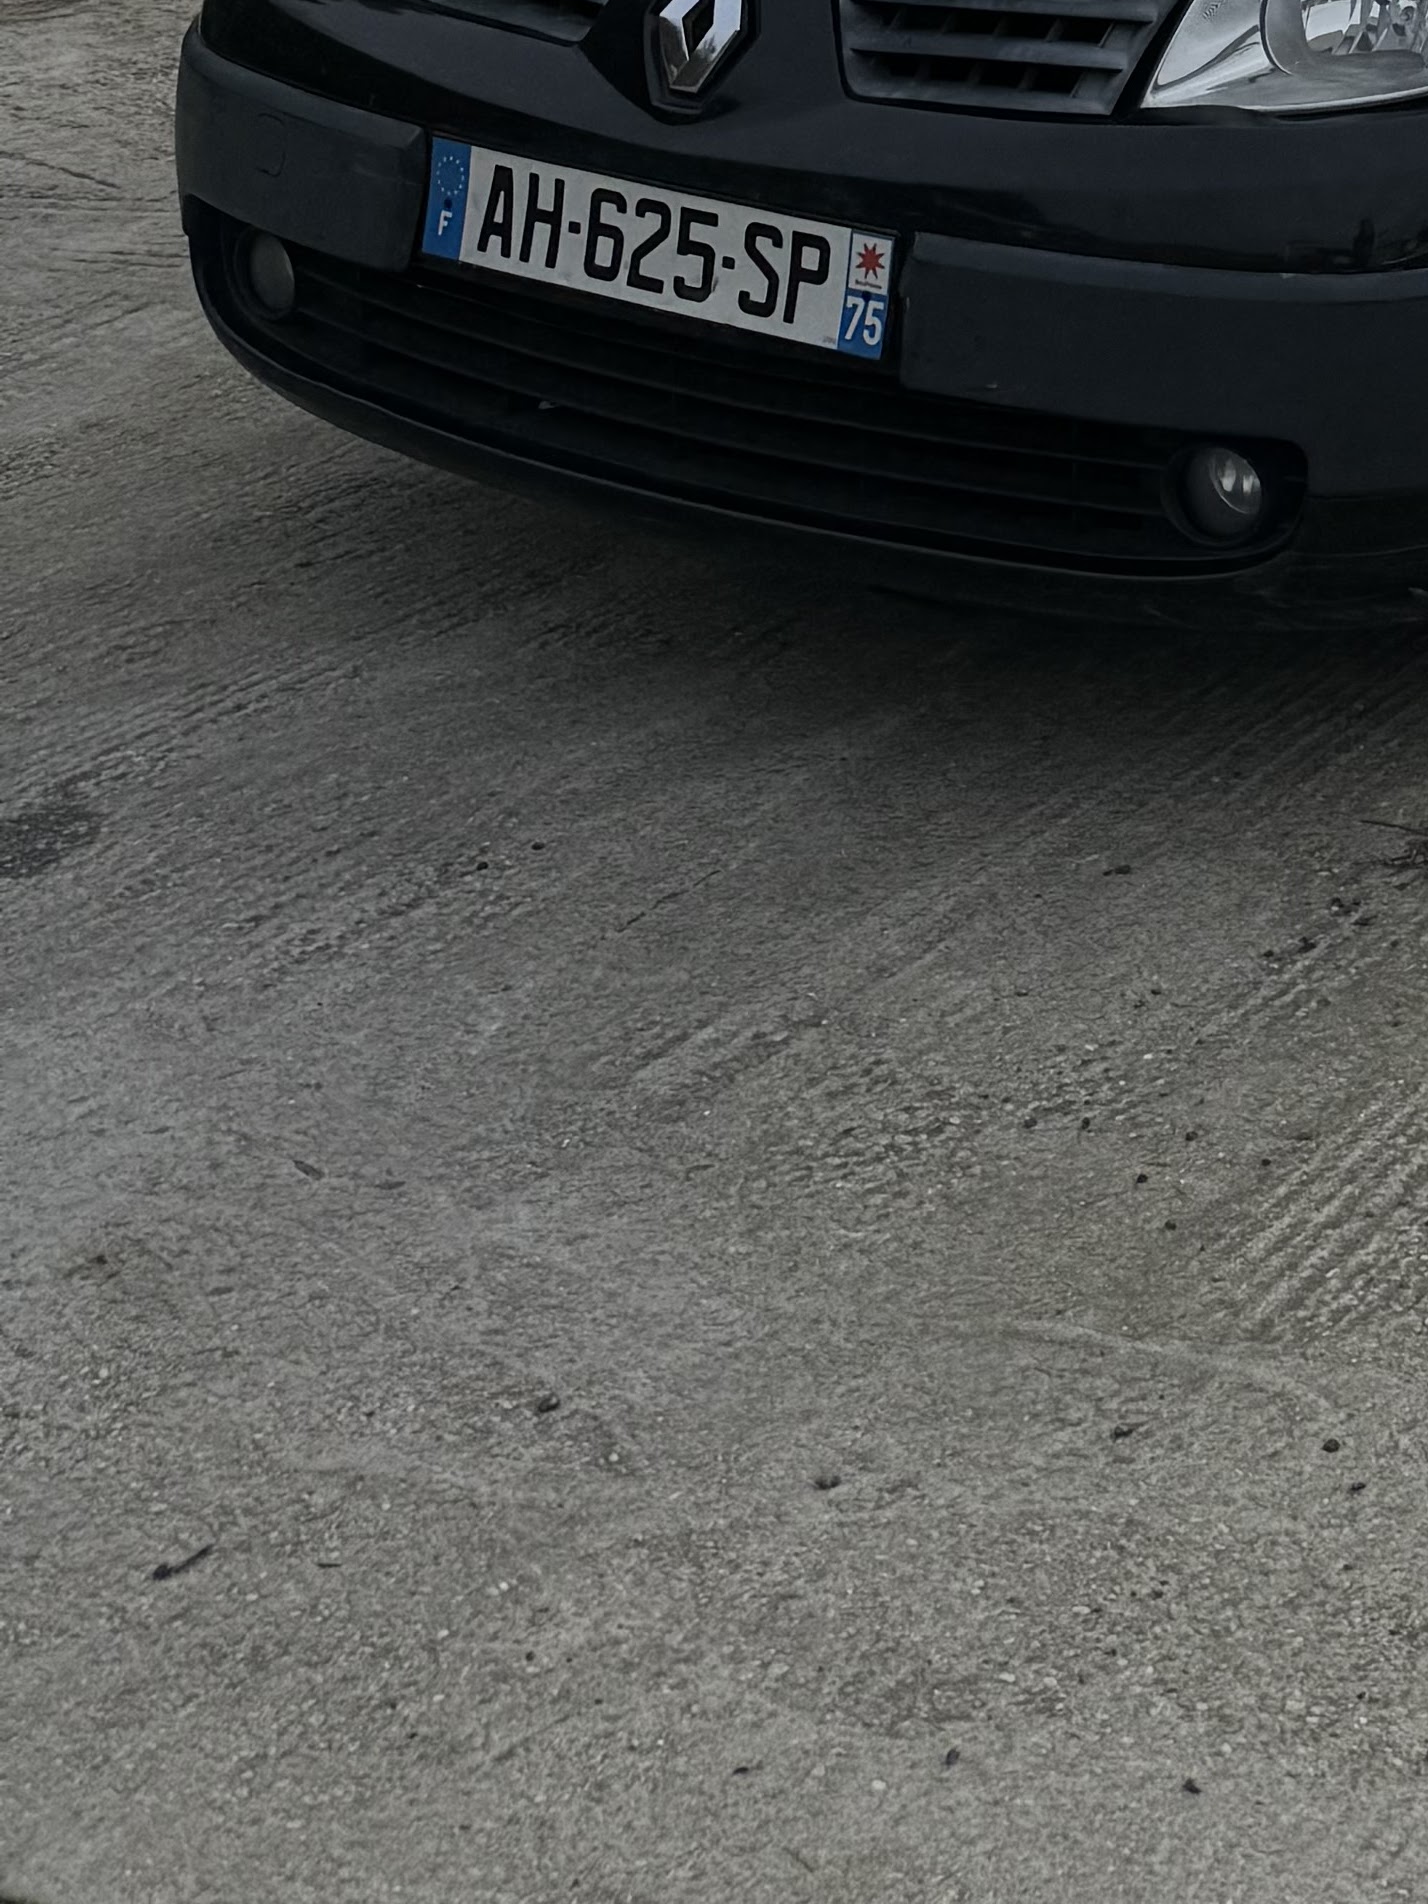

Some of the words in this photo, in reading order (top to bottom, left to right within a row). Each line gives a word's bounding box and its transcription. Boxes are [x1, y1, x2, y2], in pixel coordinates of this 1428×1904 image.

[437, 209, 453, 238] F
[476, 164, 832, 325] AH-625-SP
[844, 296, 885, 347] 75
